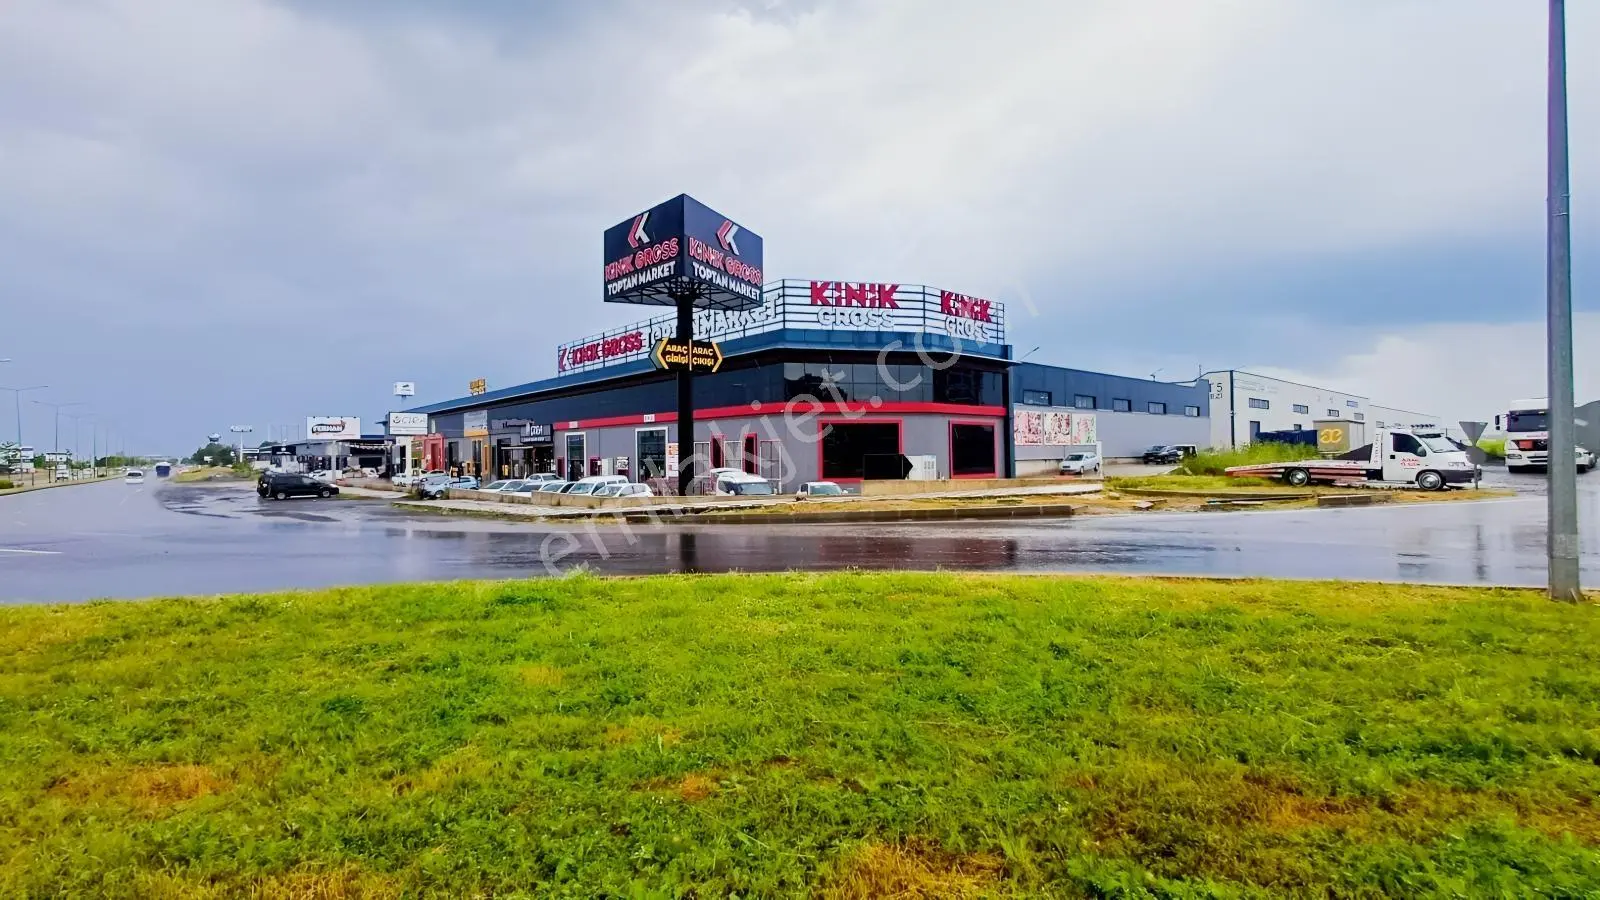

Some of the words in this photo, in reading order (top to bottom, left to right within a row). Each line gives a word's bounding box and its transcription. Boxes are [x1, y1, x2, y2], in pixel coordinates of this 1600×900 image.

[634, 237, 679, 269] GROSS
[607, 274, 639, 296] TOPTAN
[638, 261, 676, 285] MARKET
[692, 261, 729, 290] TOPTAN
[729, 277, 761, 301] MARKET
[725, 256, 763, 287] GROSS
[817, 308, 896, 328] GROSS
[945, 316, 991, 340] GROSS
[665, 344, 688, 354] ARAÇ
